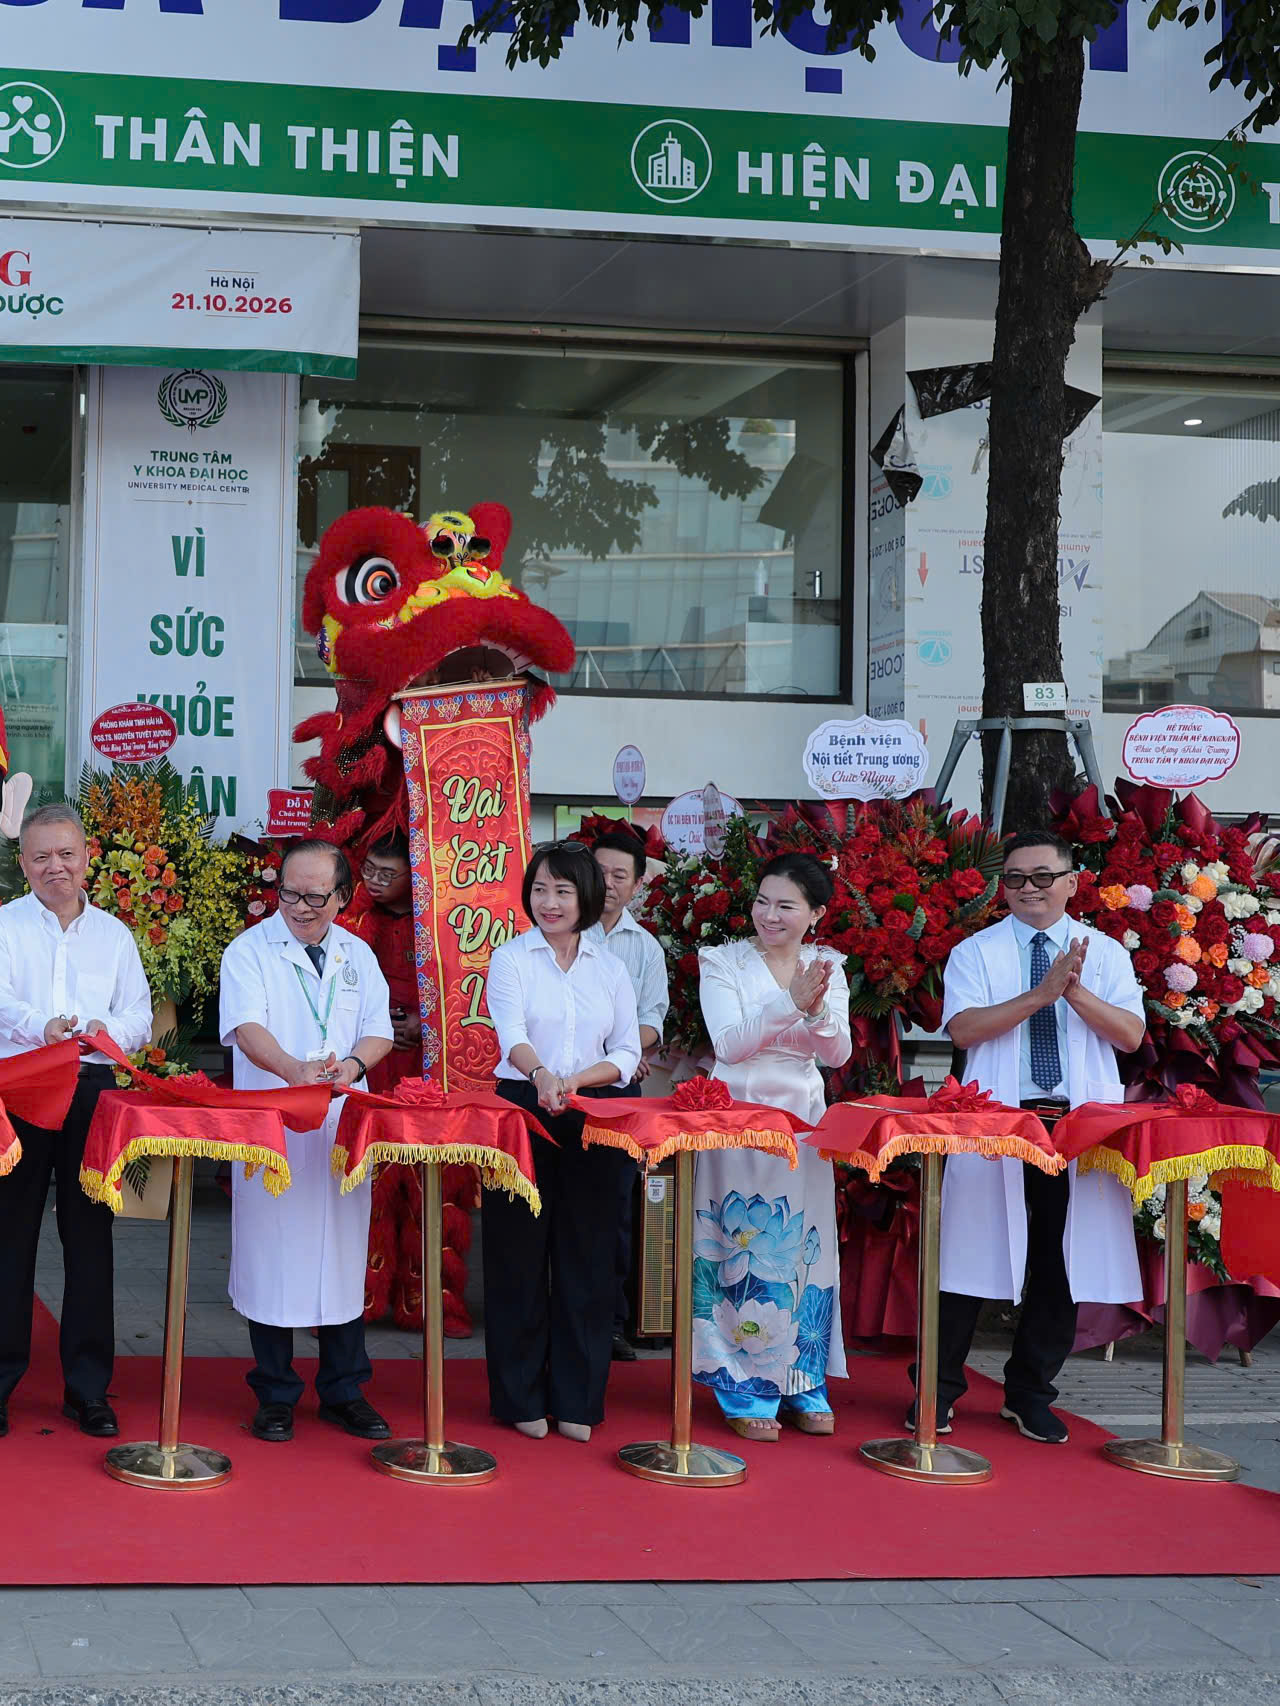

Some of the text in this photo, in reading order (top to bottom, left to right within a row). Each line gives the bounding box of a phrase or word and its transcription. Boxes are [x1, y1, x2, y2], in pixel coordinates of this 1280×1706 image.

[94, 107, 460, 188] THÂN THIỆN
[737, 142, 998, 219] HIỆN ĐẠI
[210, 276, 254, 292] Hà Nội
[171, 292, 293, 314] 21.10.2026
[178, 387, 208, 404] UMP
[150, 450, 232, 465] TRUNG TÂM
[133, 465, 249, 483] Y KHOA ĐẠI HỌC
[128, 481, 250, 494] UNIVERSITY MEDICAL CENTER
[171, 527, 207, 577] VÌ
[149, 606, 225, 658] SỨC
[1034, 687, 1055, 700] 83
[828, 734, 902, 749] Bệnh viện
[811, 750, 920, 769] Nội tiết Trung ương
[442, 774, 506, 829] Đại
[450, 833, 513, 889] Cát
